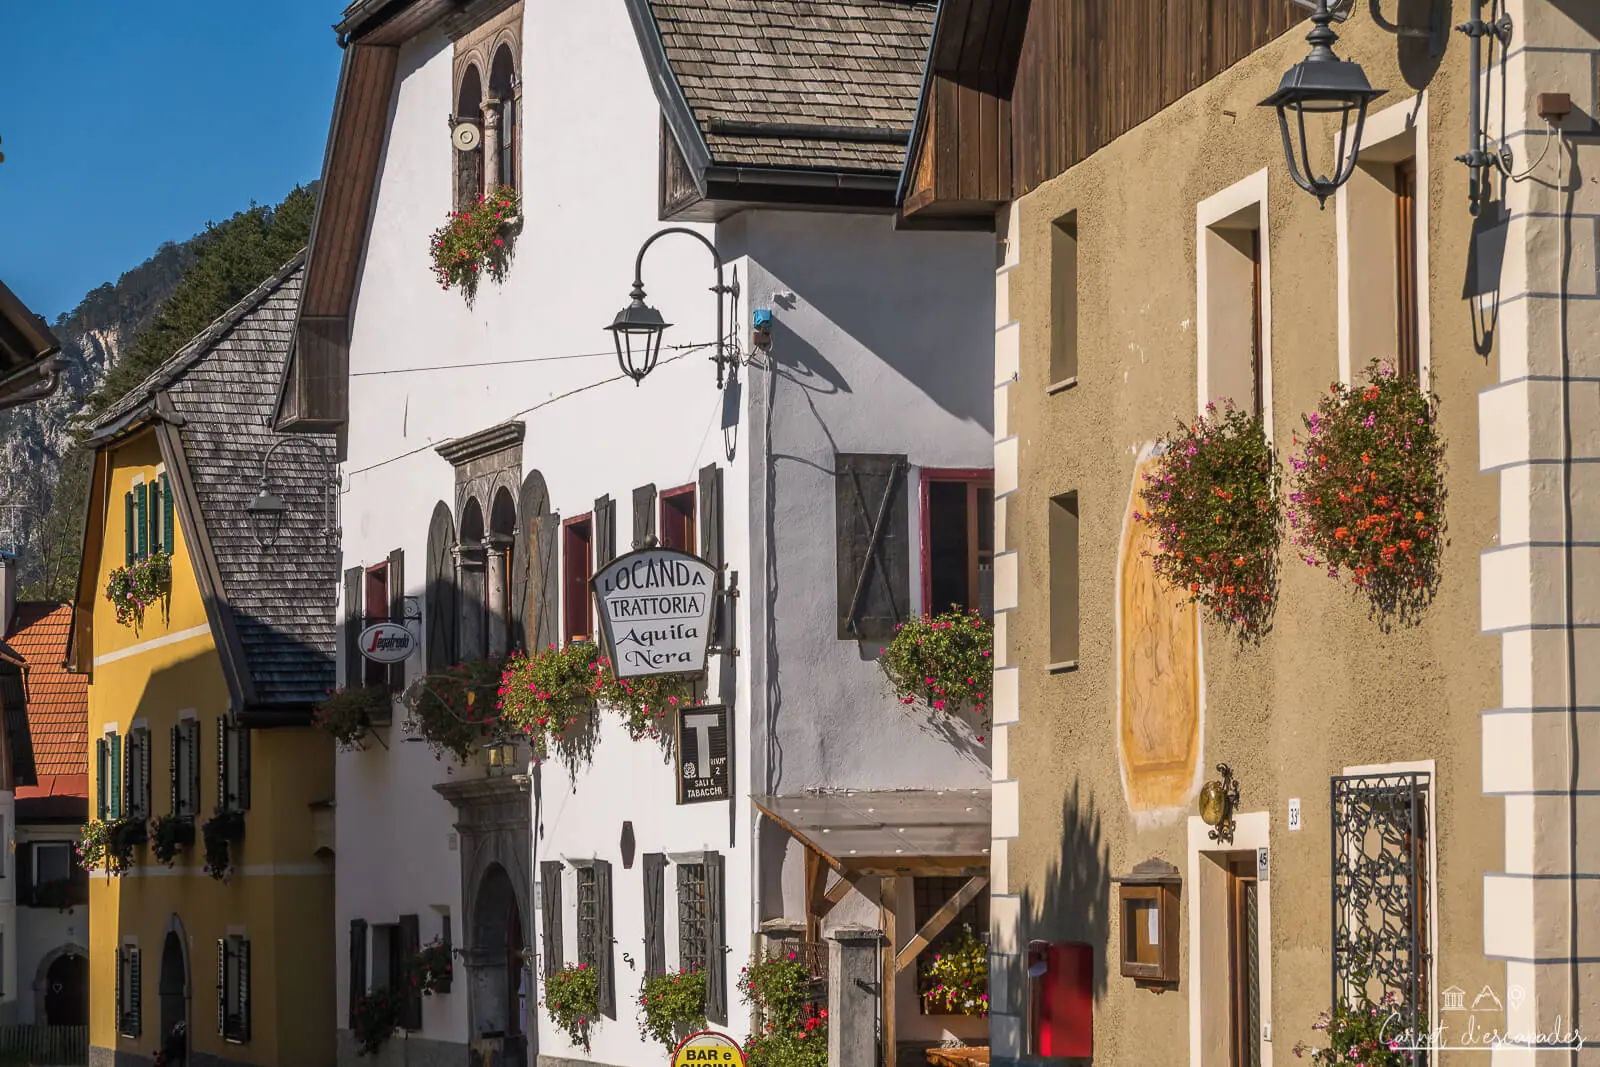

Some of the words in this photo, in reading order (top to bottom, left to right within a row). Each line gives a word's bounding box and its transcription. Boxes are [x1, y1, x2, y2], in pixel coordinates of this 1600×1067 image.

[605, 557, 706, 592] LOCANDA
[611, 596, 699, 617] TRATTORIA
[615, 623, 699, 647] Aquila
[625, 649, 692, 669] Nera
[684, 713, 719, 778] T
[715, 766, 721, 775] 2
[687, 786, 723, 798] TABACCHI
[694, 779, 709, 787] SALI
[686, 1049, 718, 1061] BAR
[723, 1051, 732, 1061] e
